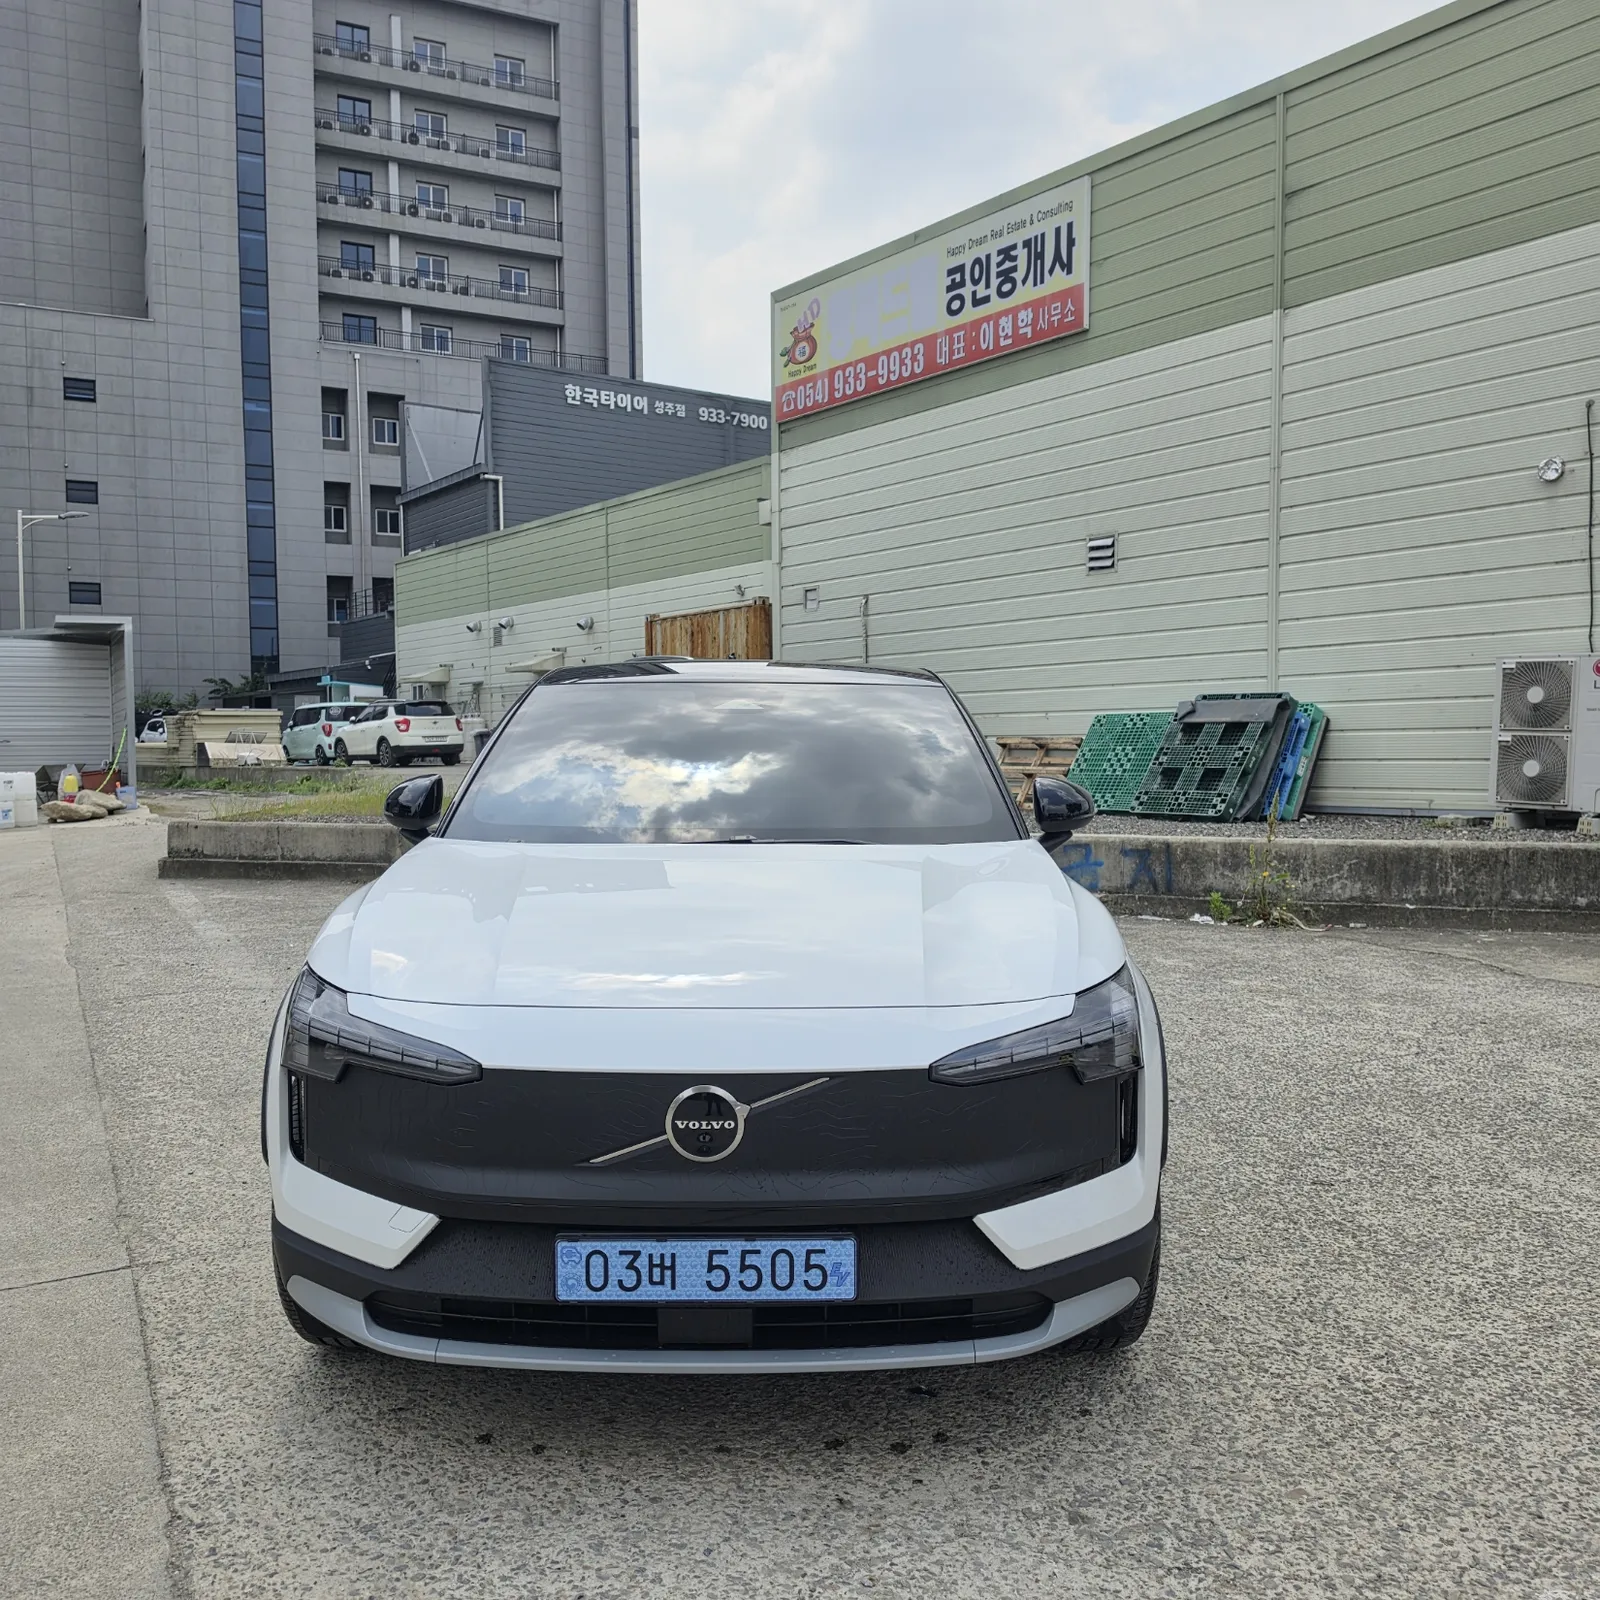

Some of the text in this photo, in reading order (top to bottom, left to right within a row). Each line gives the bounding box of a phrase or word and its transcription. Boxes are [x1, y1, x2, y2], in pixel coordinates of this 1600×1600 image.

[946, 200, 1074, 258] Happy Dream Real Estate & Consulting
[945, 220, 1076, 317] 공인중개사
[797, 377, 829, 410] 054)
[834, 342, 924, 399] 933-9933
[1037, 298, 1076, 331] 사무소
[564, 383, 768, 430] 한국타이어 성주점 933-7900
[675, 1120, 735, 1130] VOLVO
[584, 1249, 677, 1293] 03버
[705, 1248, 828, 1292] 5505
